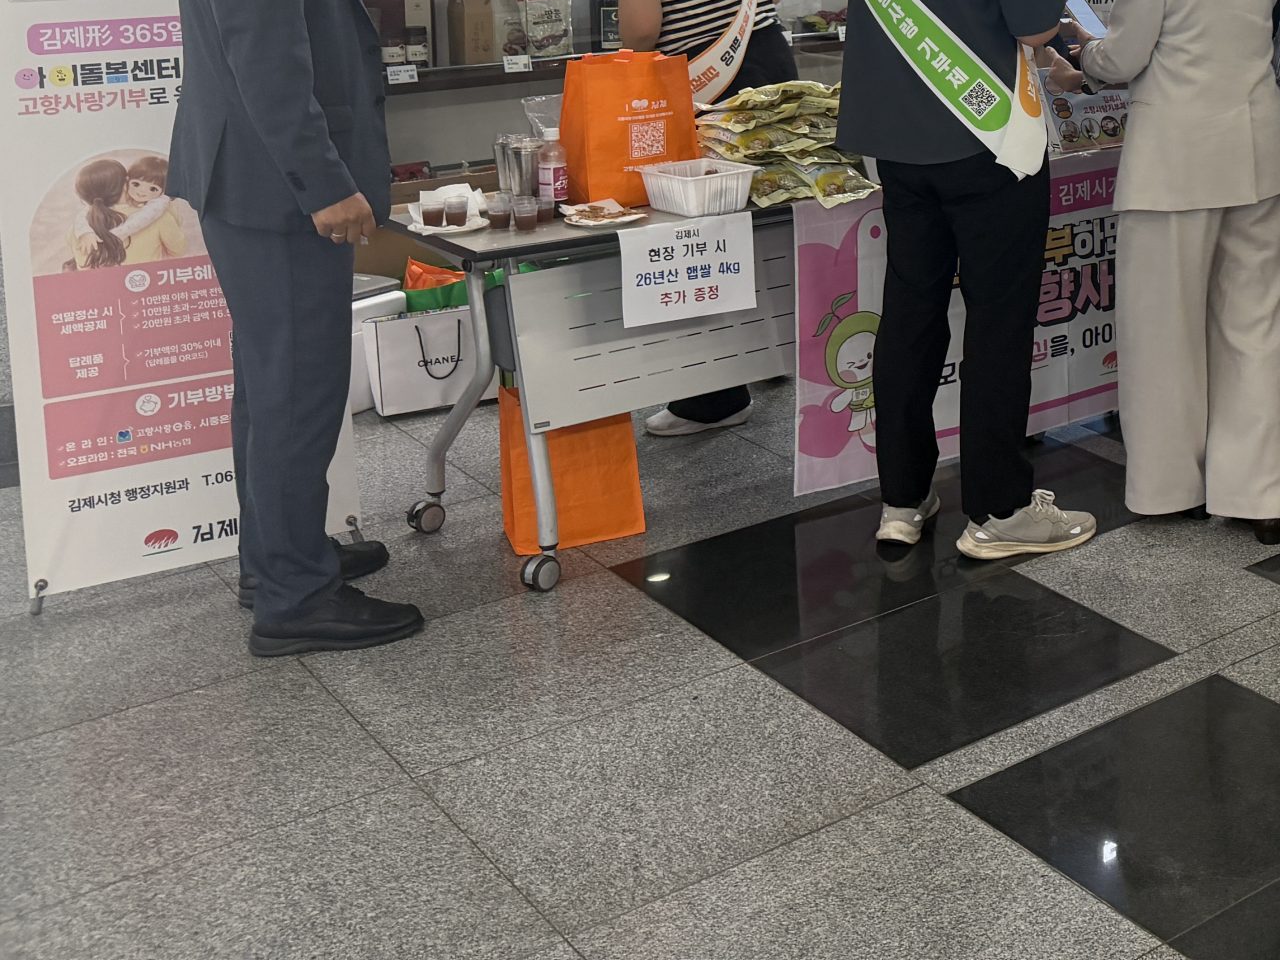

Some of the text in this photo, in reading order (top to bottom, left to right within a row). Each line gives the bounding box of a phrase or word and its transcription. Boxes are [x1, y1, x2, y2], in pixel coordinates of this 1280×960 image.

[917, 37, 969, 90] 기부제
[18, 87, 169, 116] 고향사랑기부로
[675, 228, 700, 240] 김제시
[648, 239, 727, 263] 현장 기부 시
[157, 265, 215, 286] 기부혜
[636, 262, 740, 287] 26년산 햅쌀 4kg
[141, 295, 170, 306] 10만원
[171, 292, 188, 302] 이하
[191, 288, 209, 299] 금액
[660, 285, 719, 307] 추가 증정
[1036, 261, 1117, 324] 향사
[51, 306, 113, 324] 연말정산 시
[141, 305, 171, 318] 10만원
[142, 317, 172, 330] 20만원
[174, 315, 191, 325] 초과
[192, 312, 210, 322] 금액
[60, 320, 107, 335] 세액공제
[143, 338, 222, 357] 기부액의 30% 이내
[418, 355, 463, 368] CHANEL
[76, 367, 99, 379] 제공
[200, 413, 232, 427] 시중은
[67, 451, 108, 467] 오프라인
[117, 446, 137, 458] 전국
[68, 470, 236, 512] 김제시청 행정지원과 T.06
[192, 518, 239, 544] 김제
